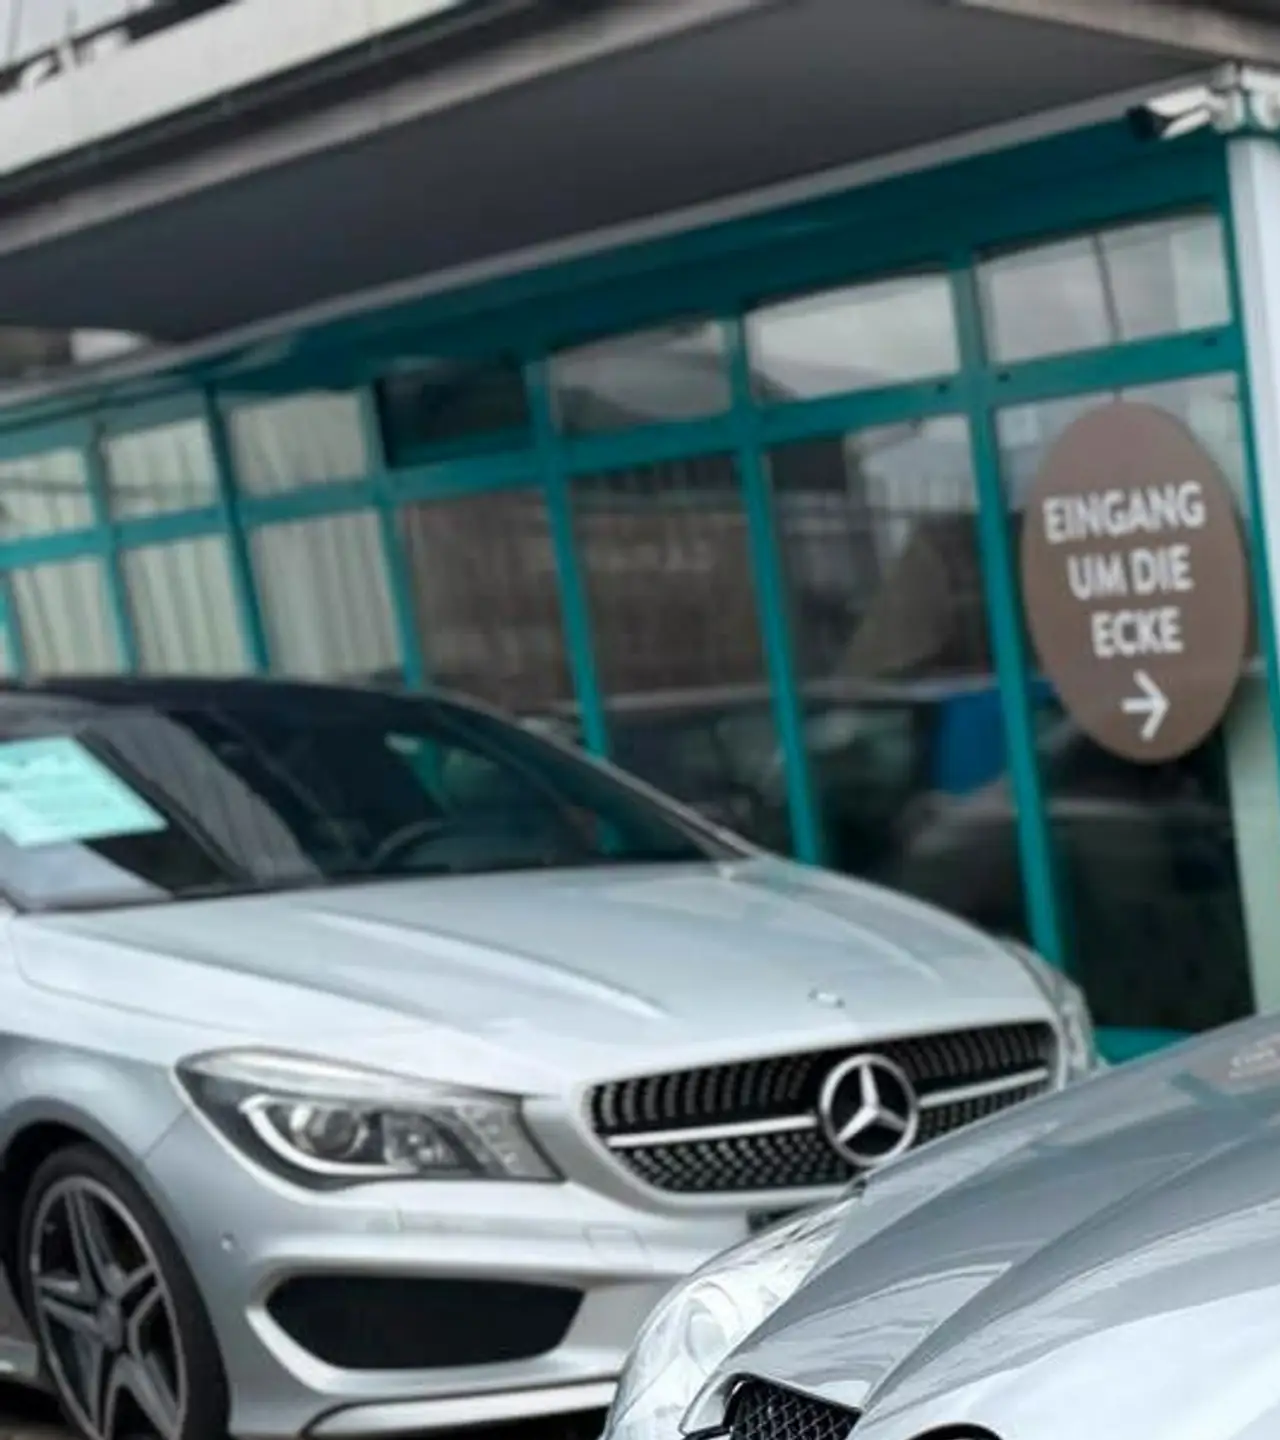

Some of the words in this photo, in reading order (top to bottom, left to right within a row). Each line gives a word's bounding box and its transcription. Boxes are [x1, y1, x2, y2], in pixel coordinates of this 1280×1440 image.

[1042, 480, 1206, 544] EINGANG
[1067, 555, 1128, 601] UM
[1130, 543, 1194, 596] DIE
[1091, 606, 1184, 658] ECKE
